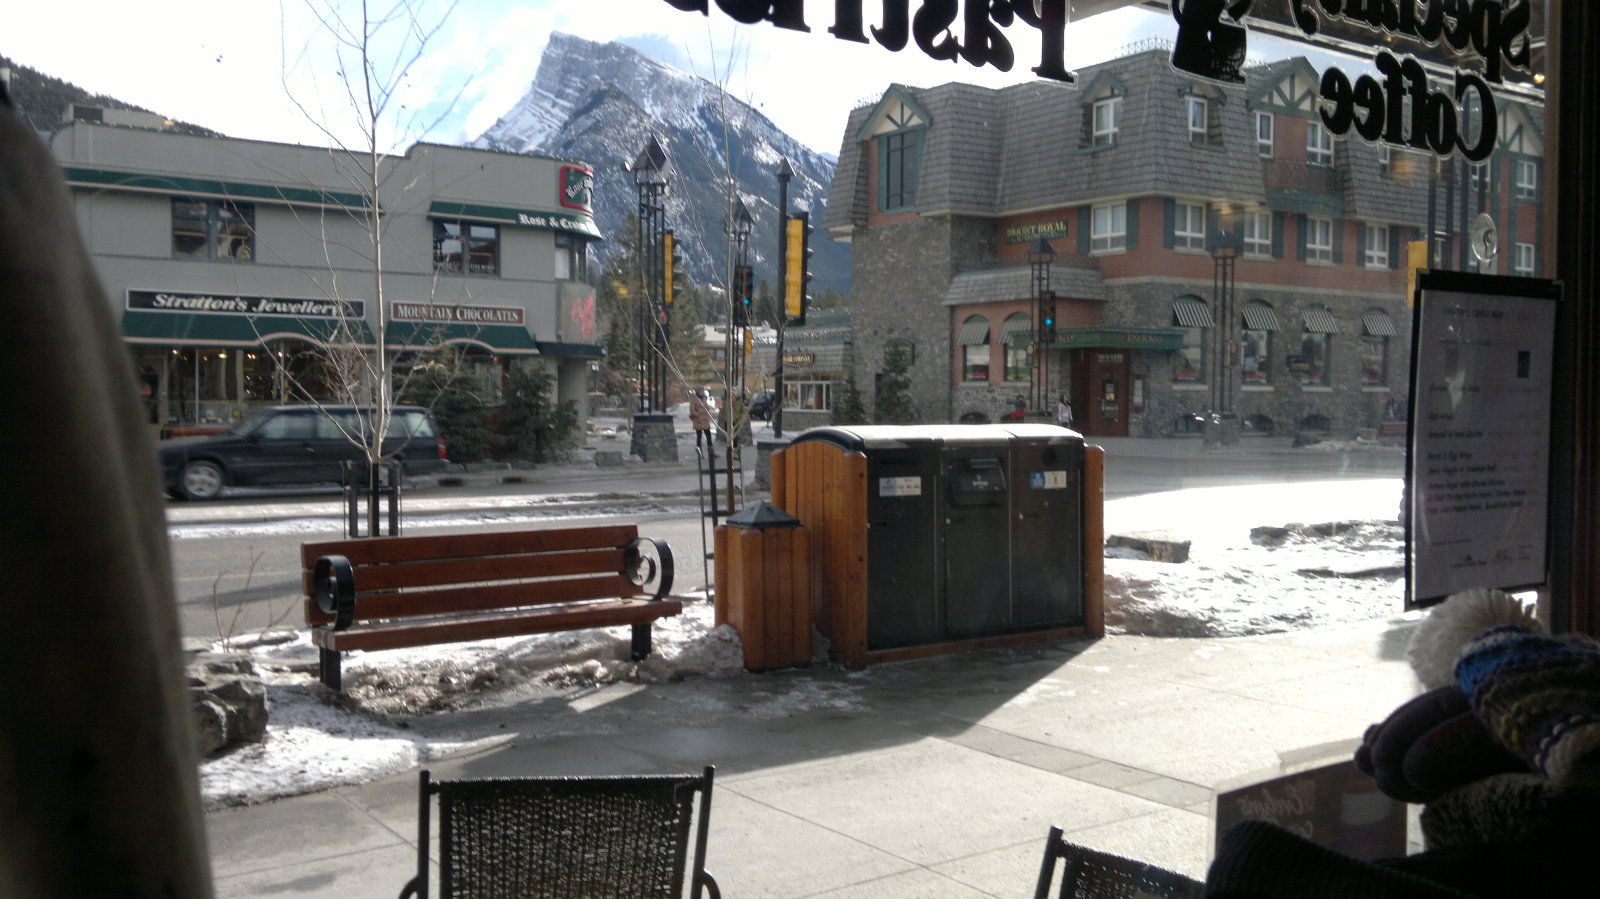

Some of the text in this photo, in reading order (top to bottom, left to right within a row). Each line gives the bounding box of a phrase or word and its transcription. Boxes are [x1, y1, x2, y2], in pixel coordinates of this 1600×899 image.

[153, 292, 341, 317] Stratton's Jewellery
[397, 303, 519, 321] MOUNTAIN CHOCOLATES
